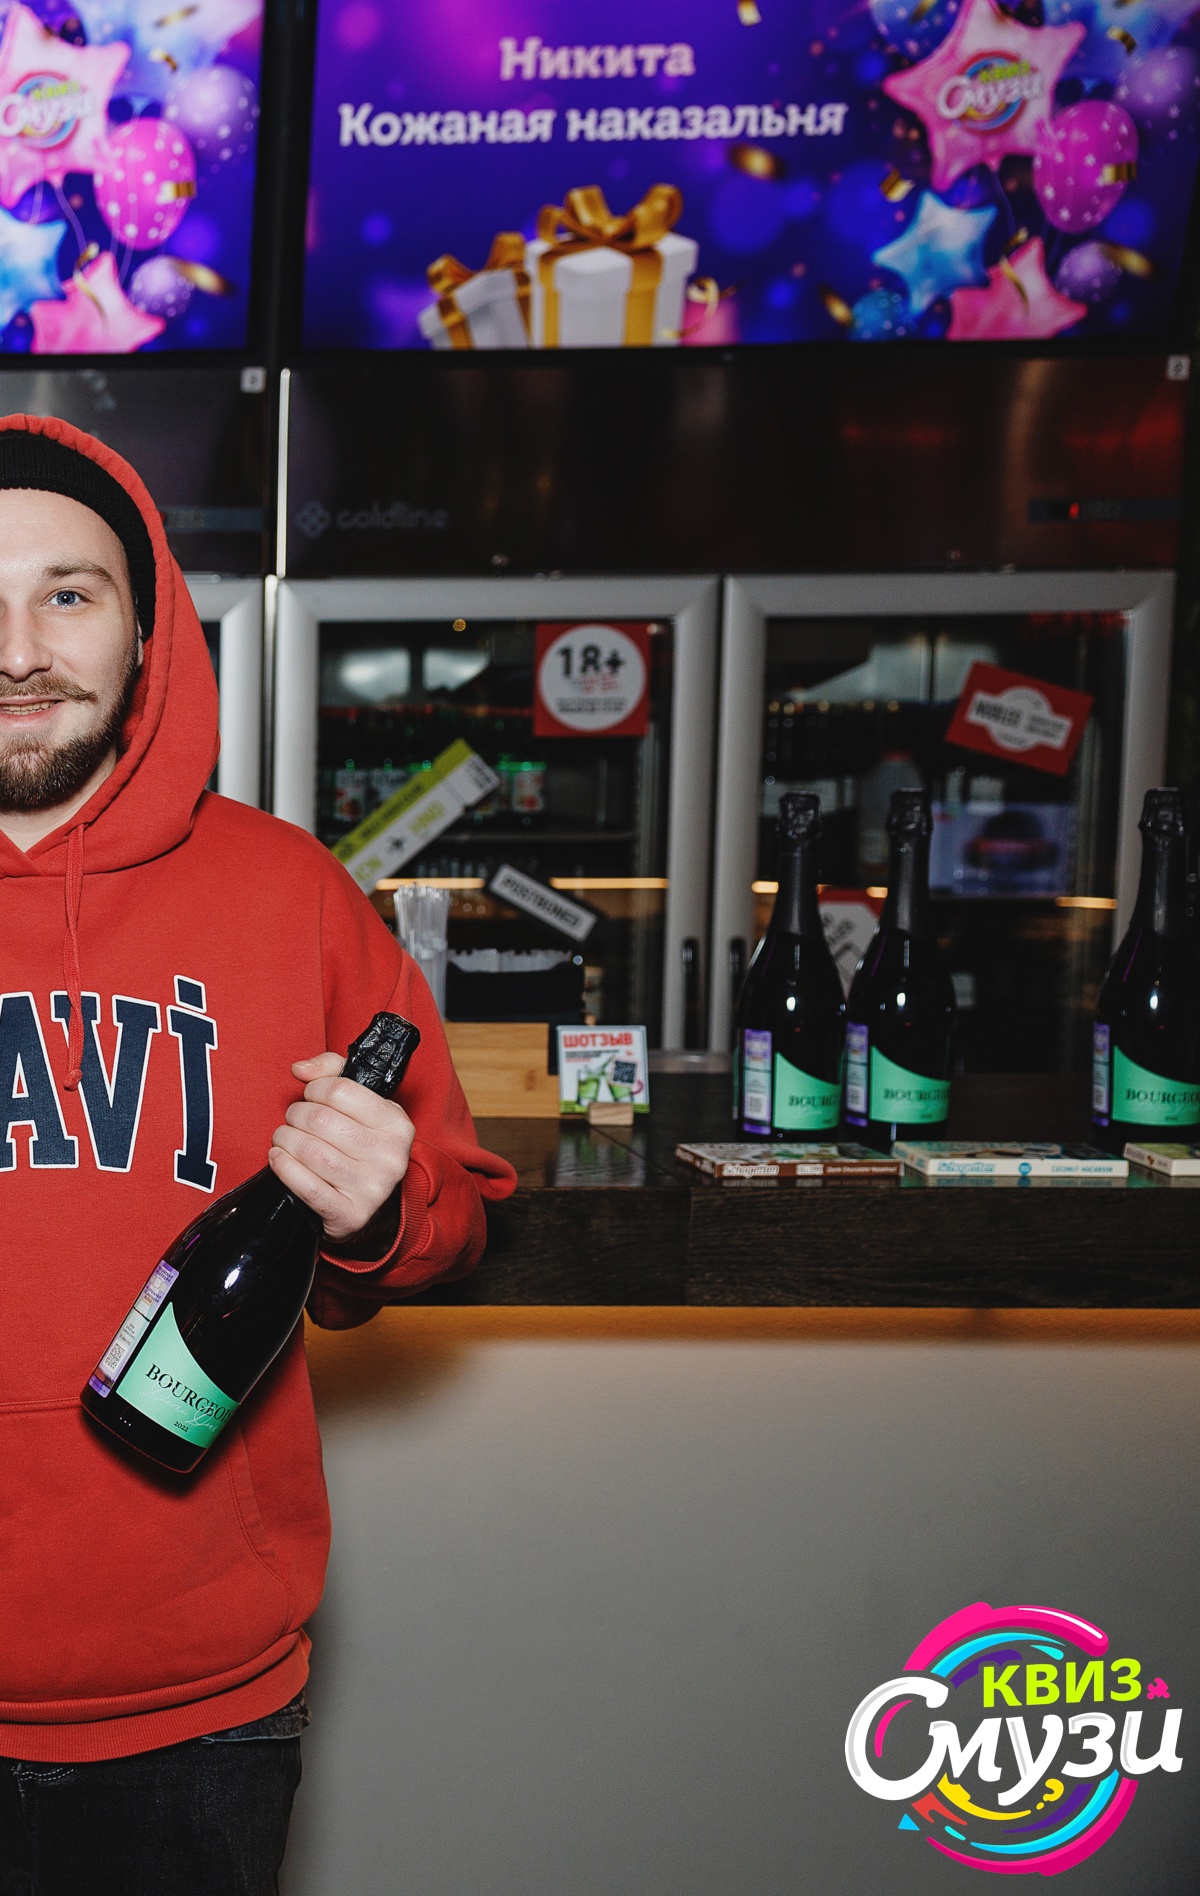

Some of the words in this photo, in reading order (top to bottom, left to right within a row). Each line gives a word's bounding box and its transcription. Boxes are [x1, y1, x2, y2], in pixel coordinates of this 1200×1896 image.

[499, 36, 696, 80] Никита
[338, 102, 556, 146] Кожаная
[566, 102, 848, 141] наказальня
[557, 644, 626, 677] 18+
[563, 1032, 633, 1048] ШОТЗЫВ
[173, 1420, 189, 1433] 2022
